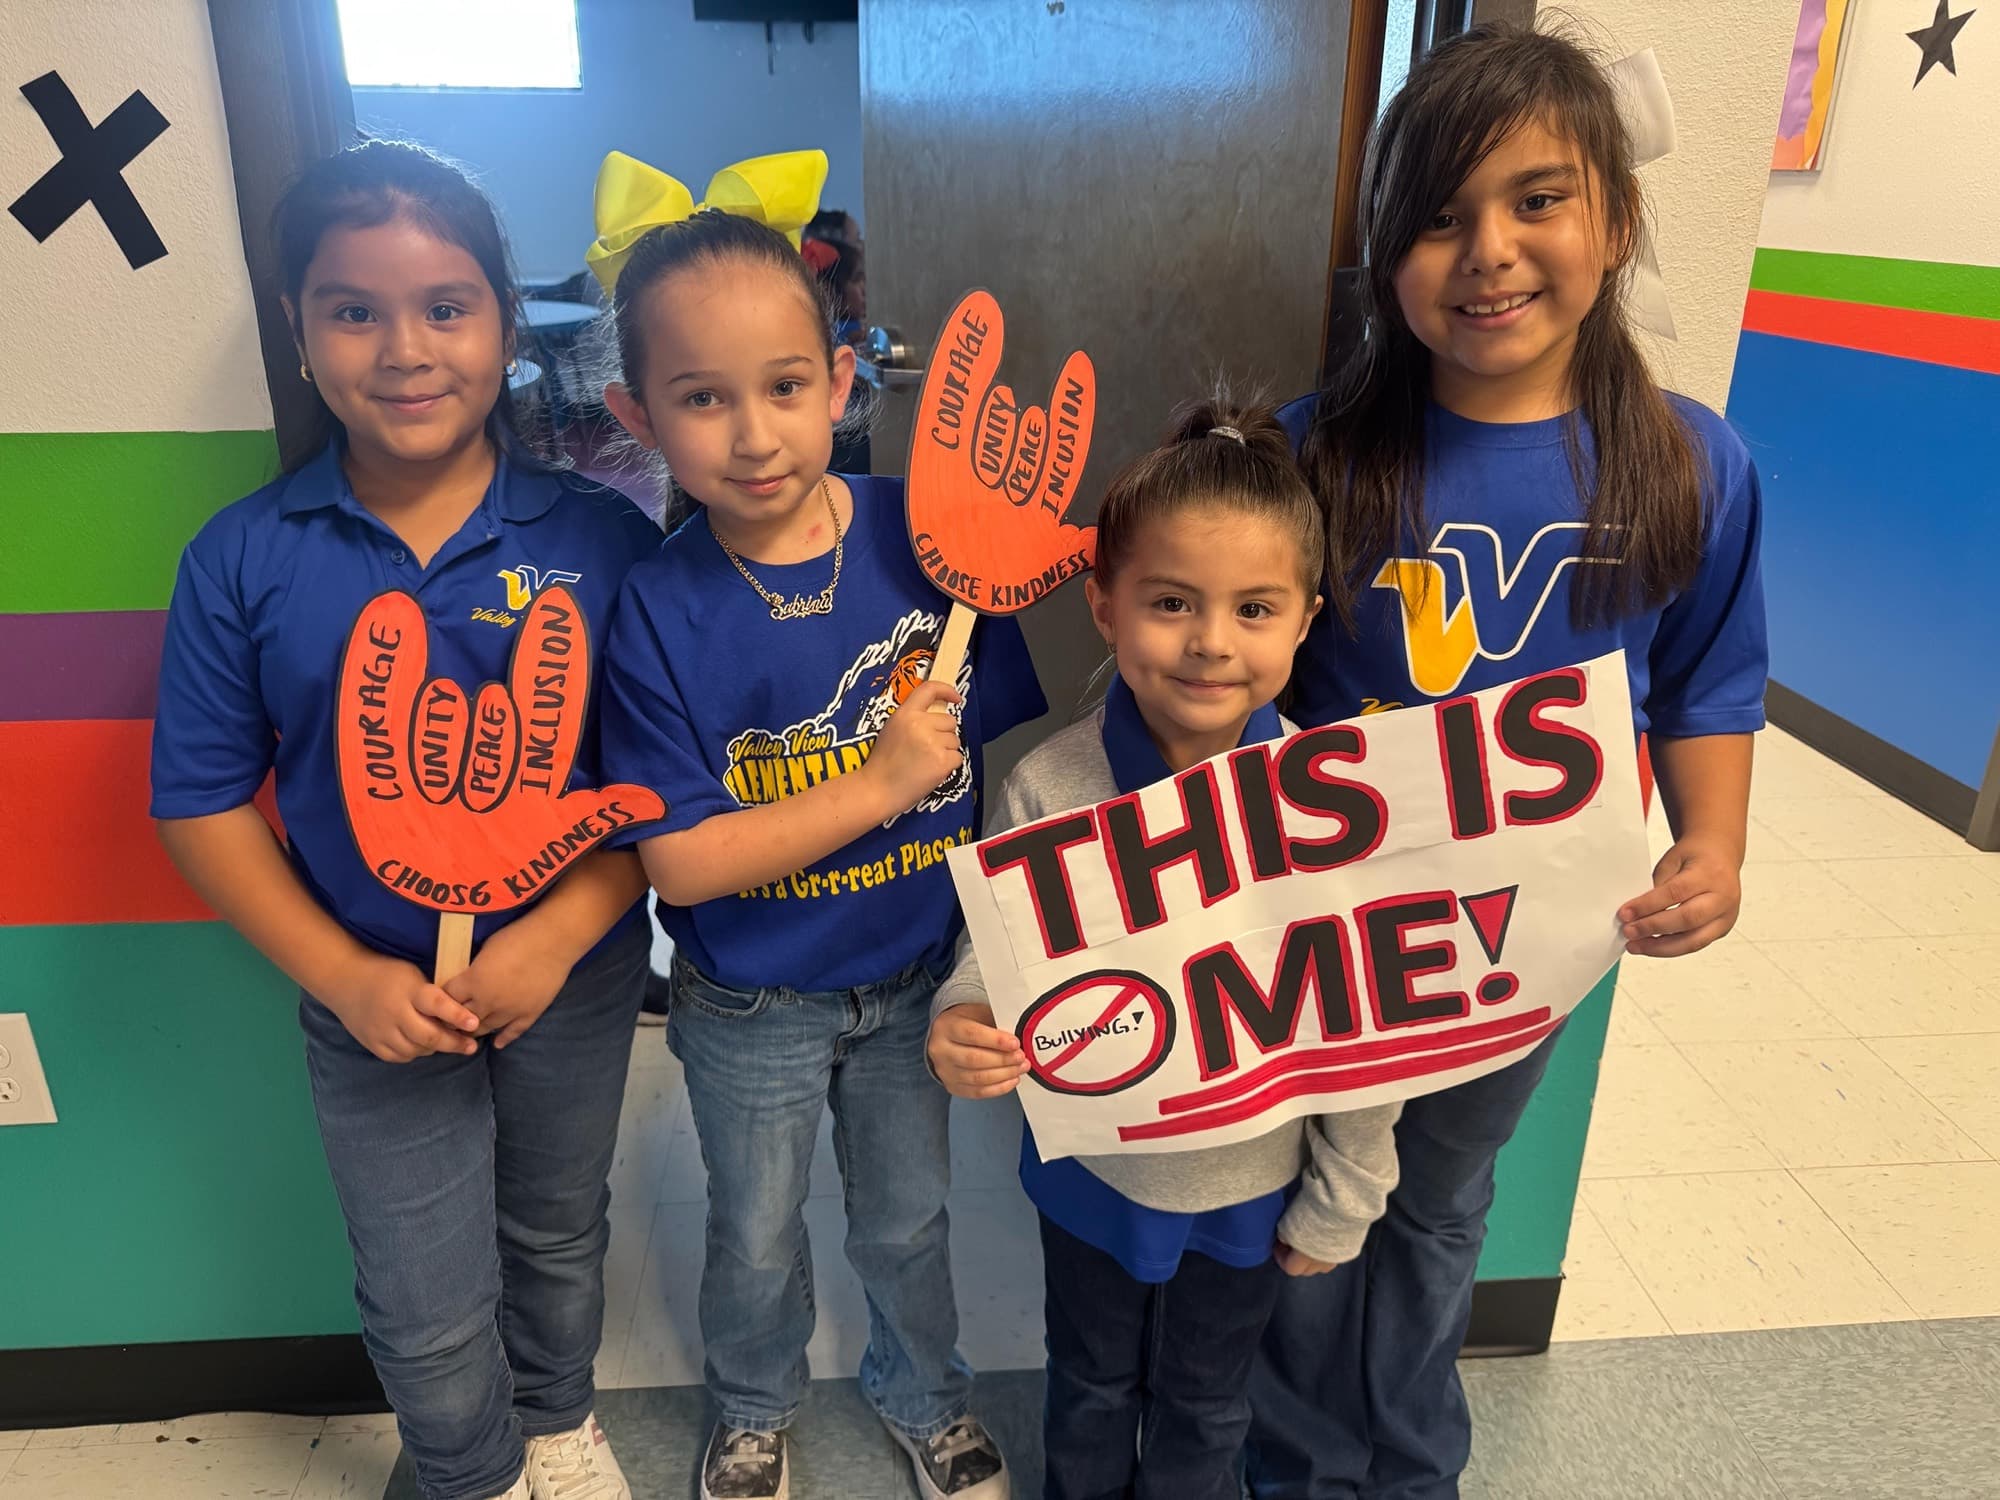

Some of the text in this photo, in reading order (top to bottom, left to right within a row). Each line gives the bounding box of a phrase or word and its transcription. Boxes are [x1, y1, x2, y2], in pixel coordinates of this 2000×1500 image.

[931, 308, 989, 451] COURAGE
[979, 390, 1017, 475] UNITY
[1009, 418, 1042, 496] PEACE
[1040, 377, 1084, 519] INCUSION
[471, 607, 517, 628] Valley
[770, 591, 834, 620] Sabrina
[915, 532, 1091, 608] CHOOSE KINDNESS
[357, 621, 405, 801] COURAGE
[421, 684, 458, 789] UNITY
[520, 604, 575, 795] INCLUSION
[729, 726, 831, 762] Valley View
[470, 702, 507, 795] PEACE
[503, 801, 635, 898] KINDNESS
[977, 666, 1604, 959] THIS IS
[790, 852, 896, 899] Gr-r-reat
[900, 836, 955, 876] Place
[1182, 884, 1520, 1082] ME!
